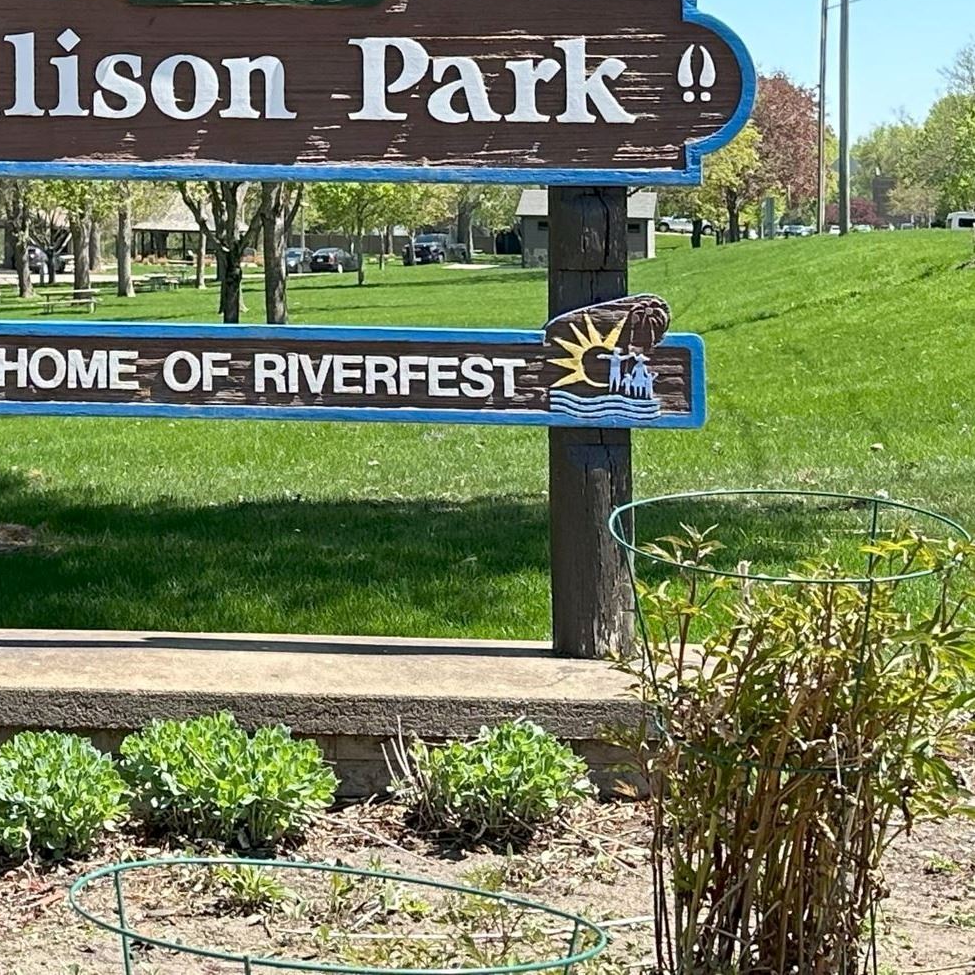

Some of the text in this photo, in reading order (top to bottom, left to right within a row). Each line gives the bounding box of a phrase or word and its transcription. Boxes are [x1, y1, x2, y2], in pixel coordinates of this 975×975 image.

[348, 36, 638, 125] Park
[162, 349, 231, 393] OF
[254, 353, 527, 398] RIVERFEST
